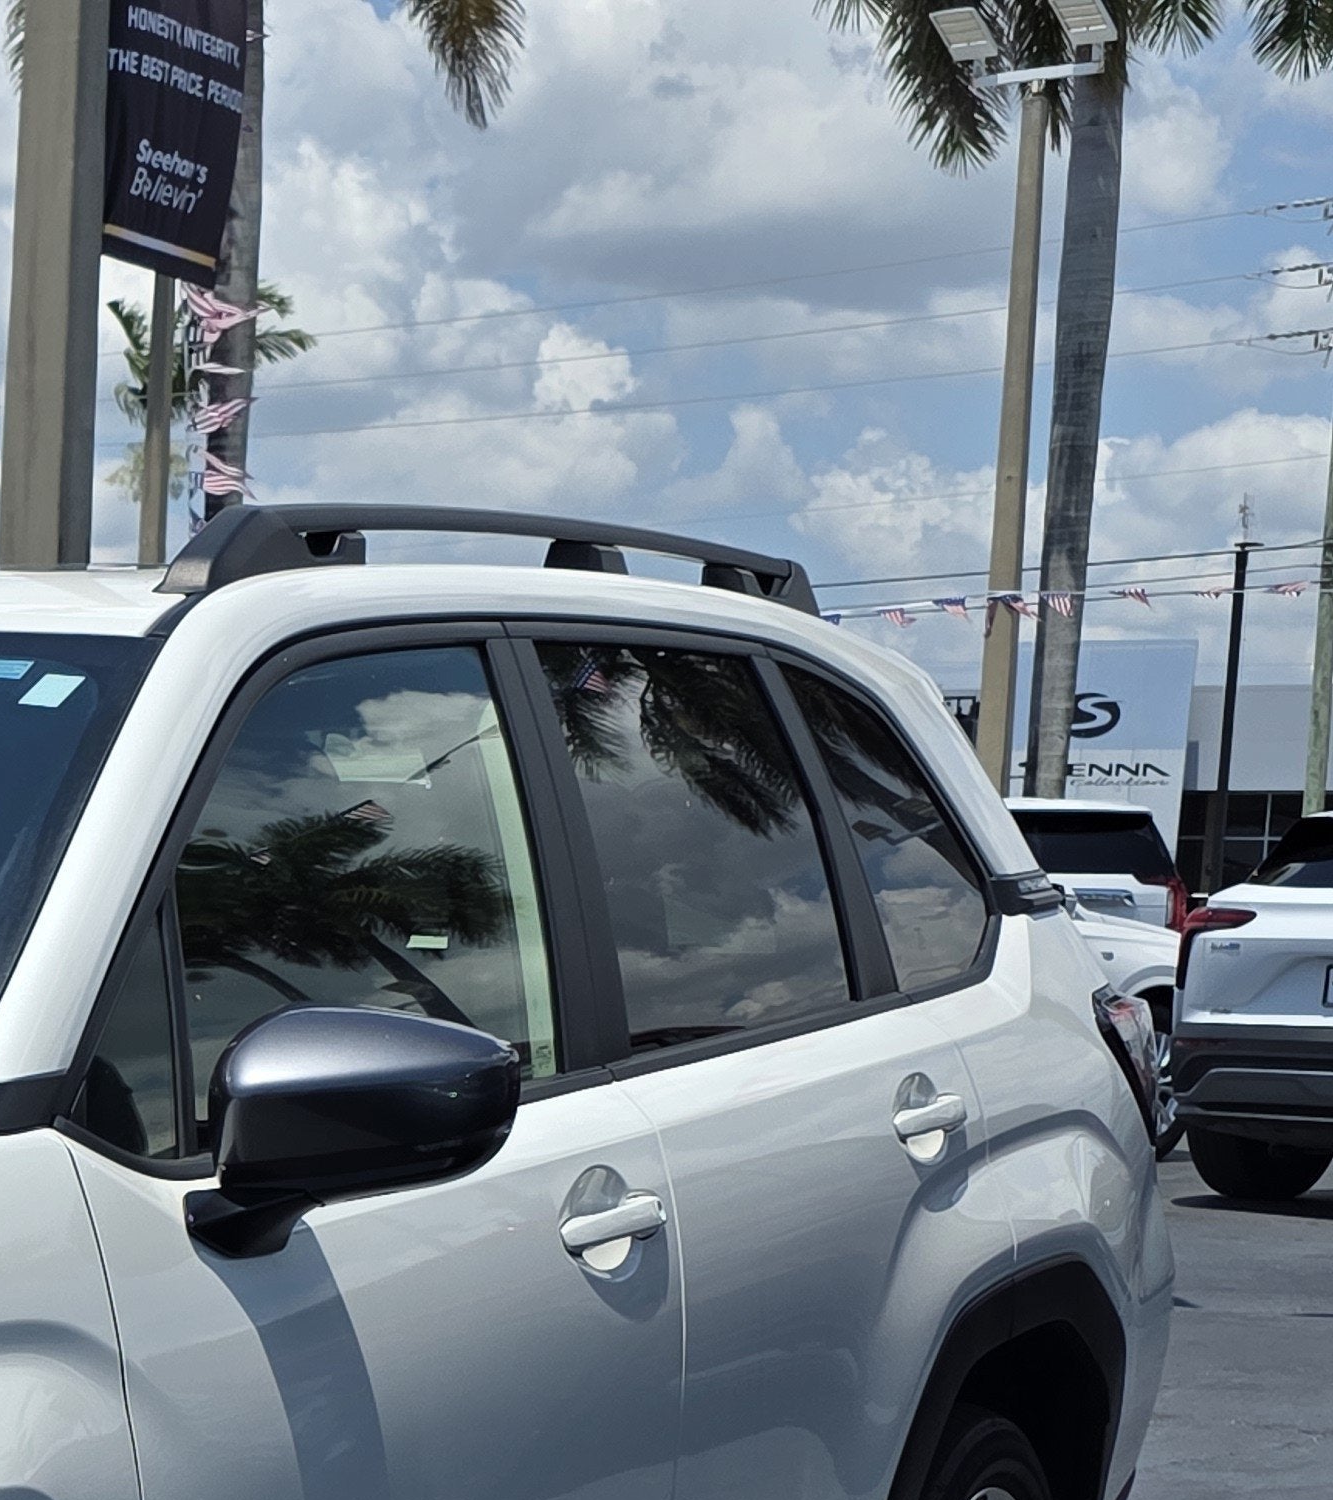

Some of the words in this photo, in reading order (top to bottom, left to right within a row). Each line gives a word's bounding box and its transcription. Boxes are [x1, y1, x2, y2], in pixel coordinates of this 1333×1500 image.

[108, 48, 140, 75] THE
[140, 54, 170, 85] BEST
[1066, 763, 1171, 777] ENNA
